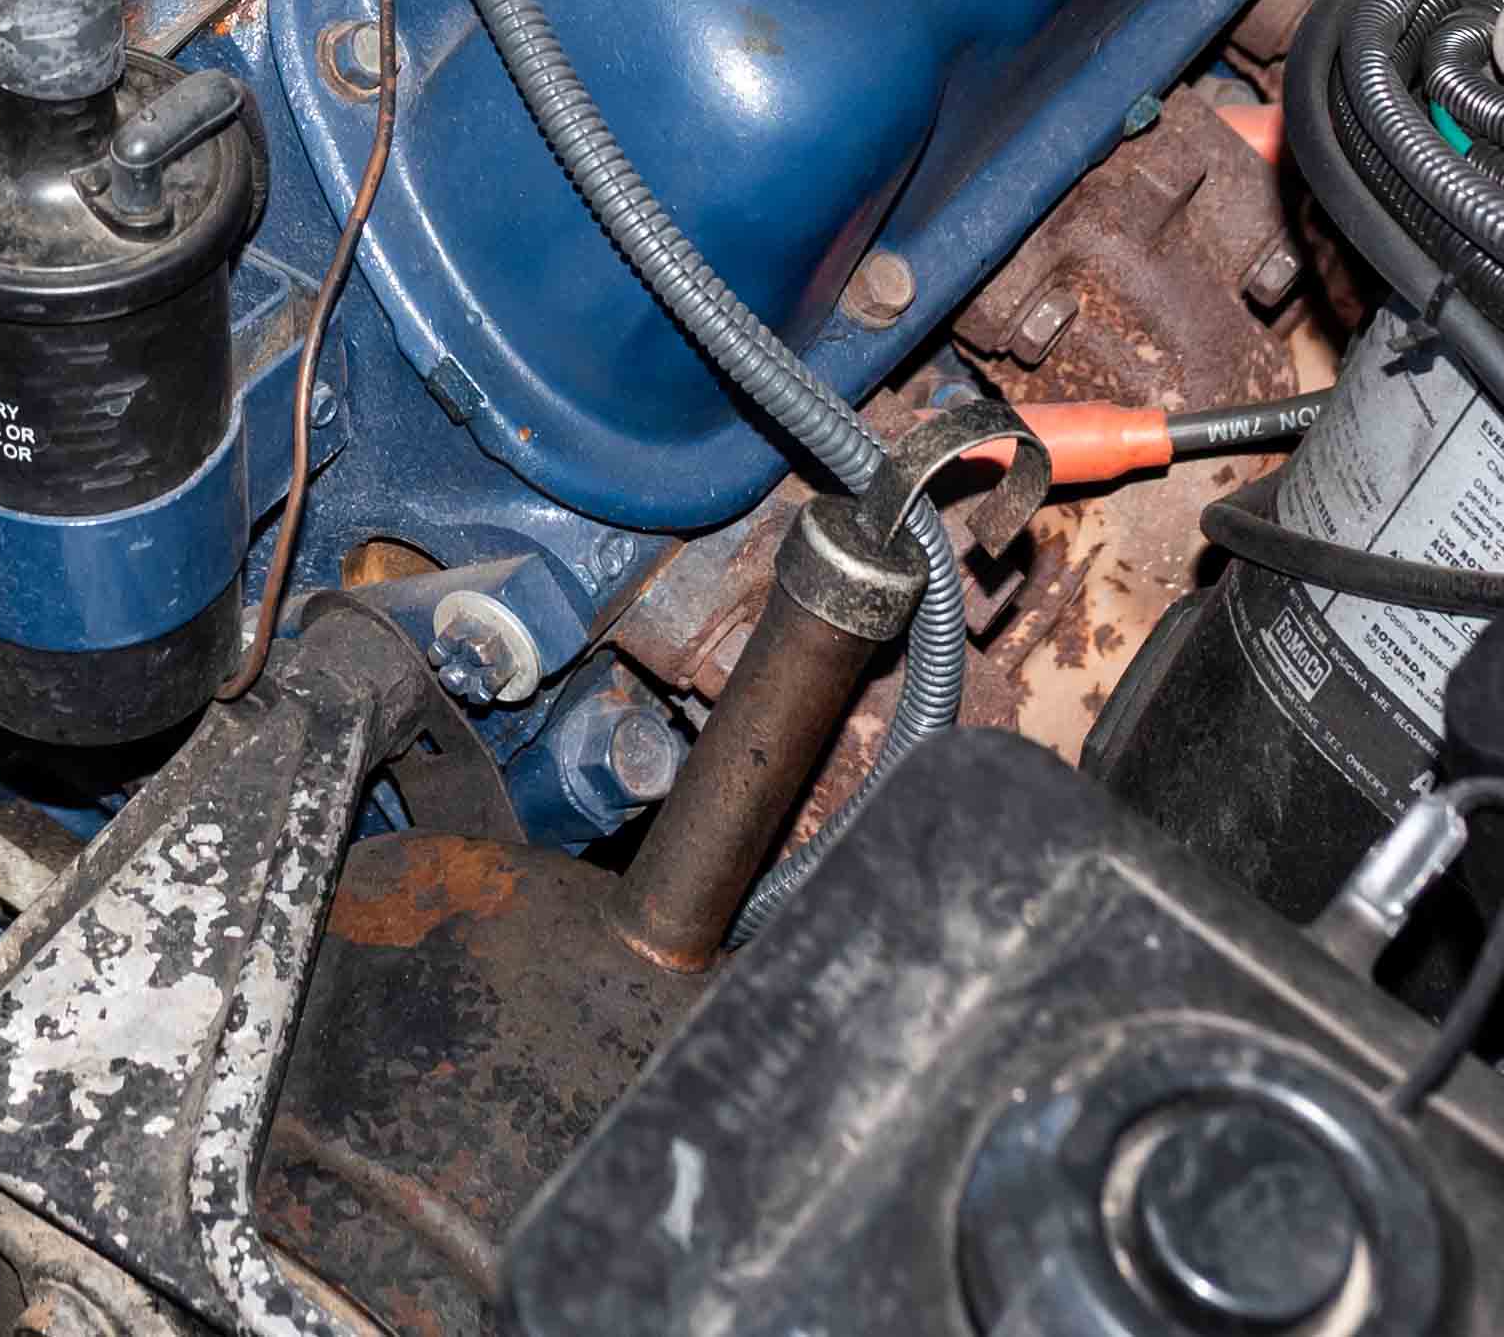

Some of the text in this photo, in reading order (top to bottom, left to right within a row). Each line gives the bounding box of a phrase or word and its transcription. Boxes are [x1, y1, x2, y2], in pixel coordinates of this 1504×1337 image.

[6, 424, 35, 444] OR
[1207, 415, 1265, 443] 7MM
[1471, 476, 1503, 510] ONLY
[1436, 527, 1458, 550] Use
[1380, 604, 1420, 646] Cooling
[1429, 623, 1459, 654] every
[1274, 620, 1328, 685] FoMoCo
[1361, 632, 1395, 667] 50/50
[1392, 662, 1417, 689] with
[1369, 621, 1428, 683] ROTUNDA
[1326, 646, 1371, 692] INSIGNIA
[1369, 689, 1392, 712] ARE
